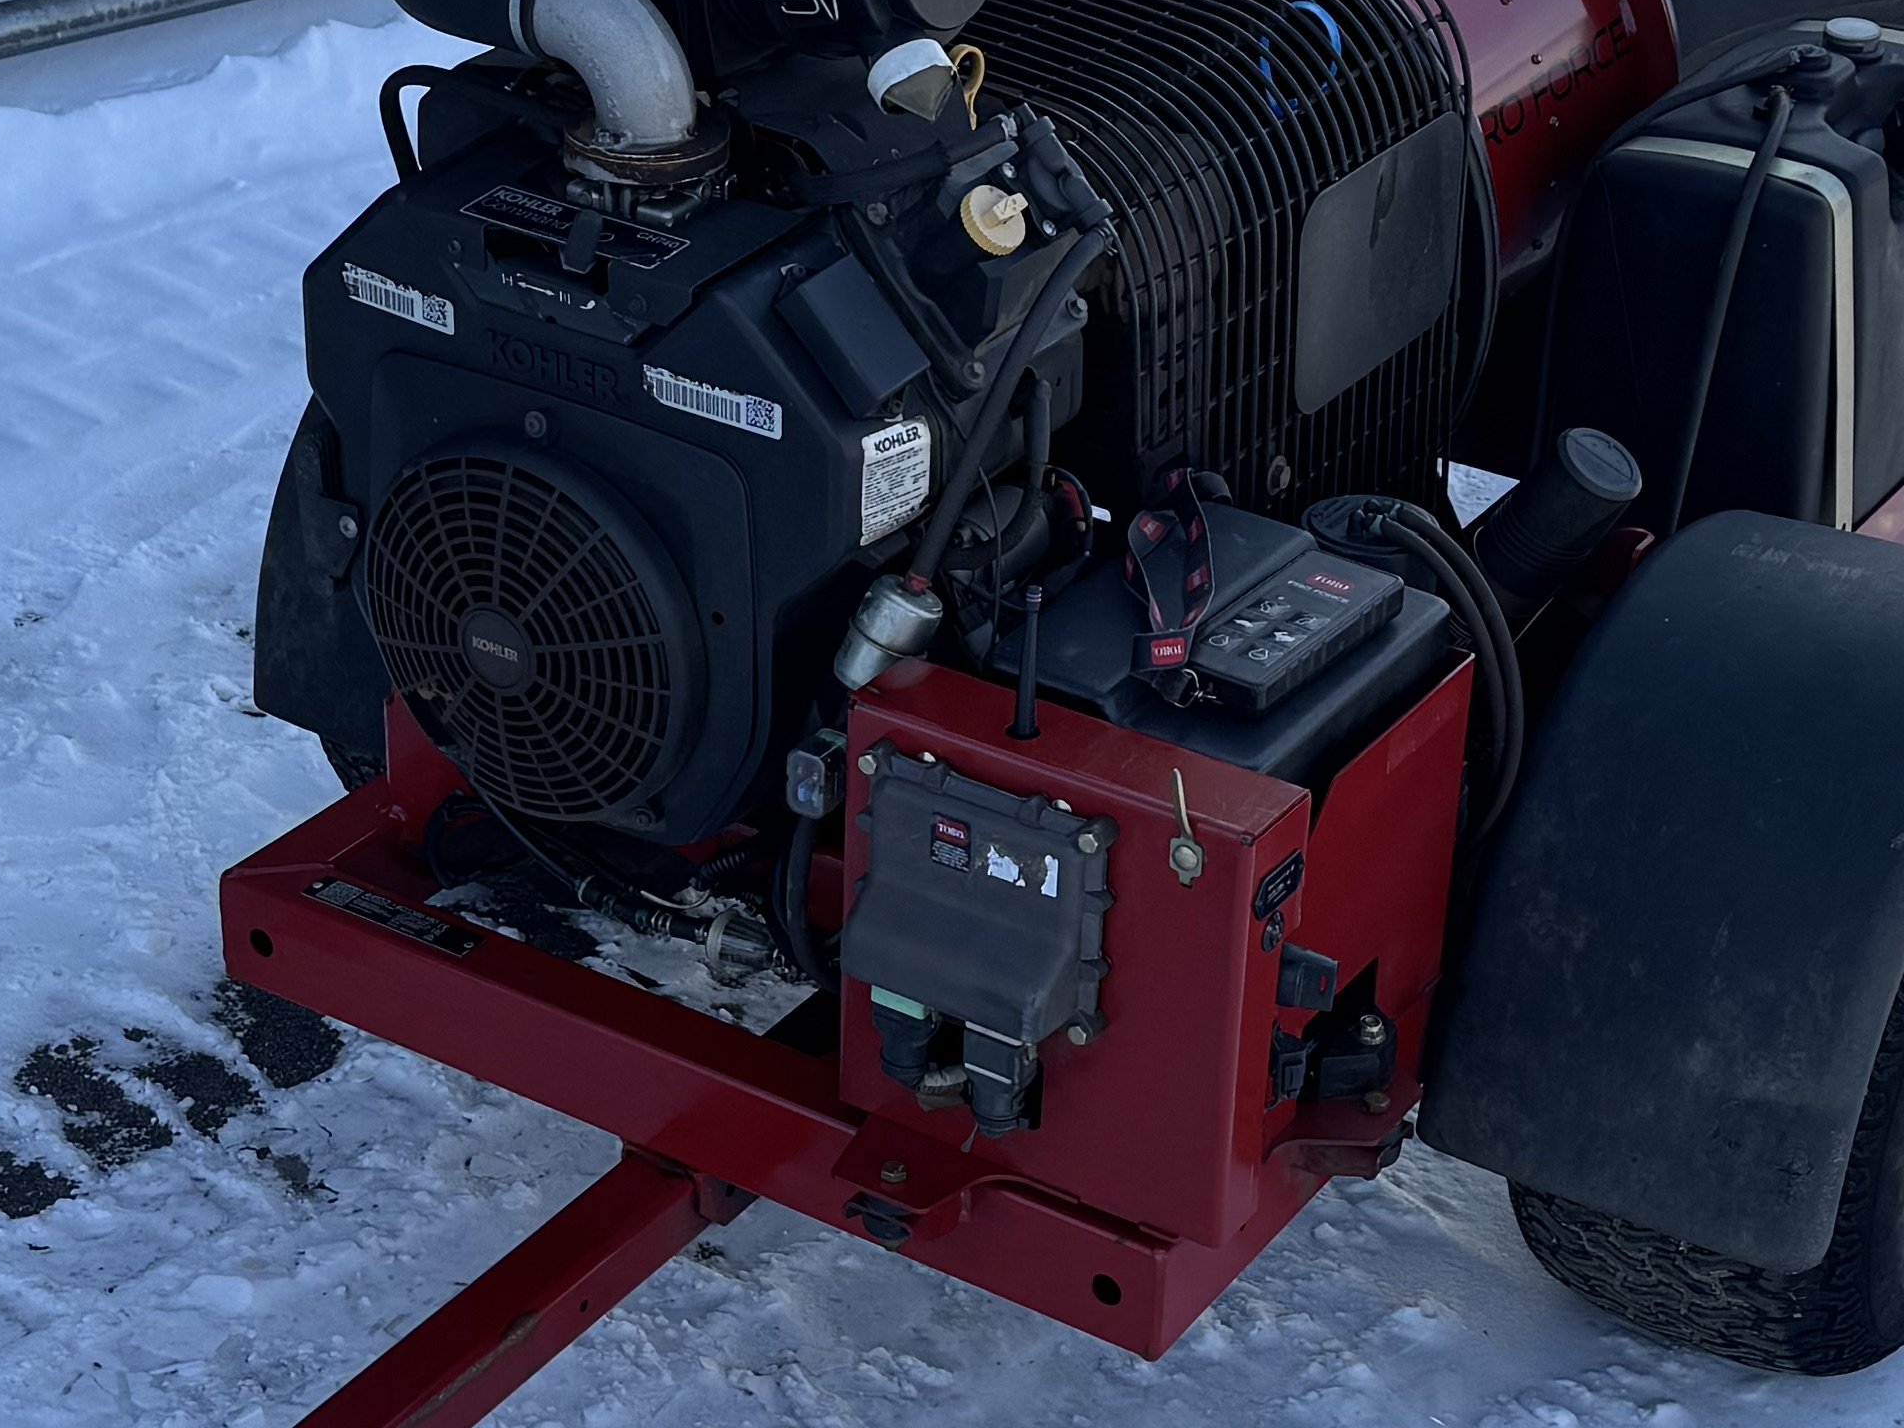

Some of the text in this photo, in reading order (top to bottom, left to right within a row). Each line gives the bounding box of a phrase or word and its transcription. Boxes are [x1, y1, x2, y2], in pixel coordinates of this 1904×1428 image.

[1478, 15, 1633, 145] RO FORCE
[490, 188, 566, 217] KOHLER
[484, 327, 622, 403] KOHLER
[873, 425, 922, 455] KOHLER
[472, 635, 519, 663] KOHLER
